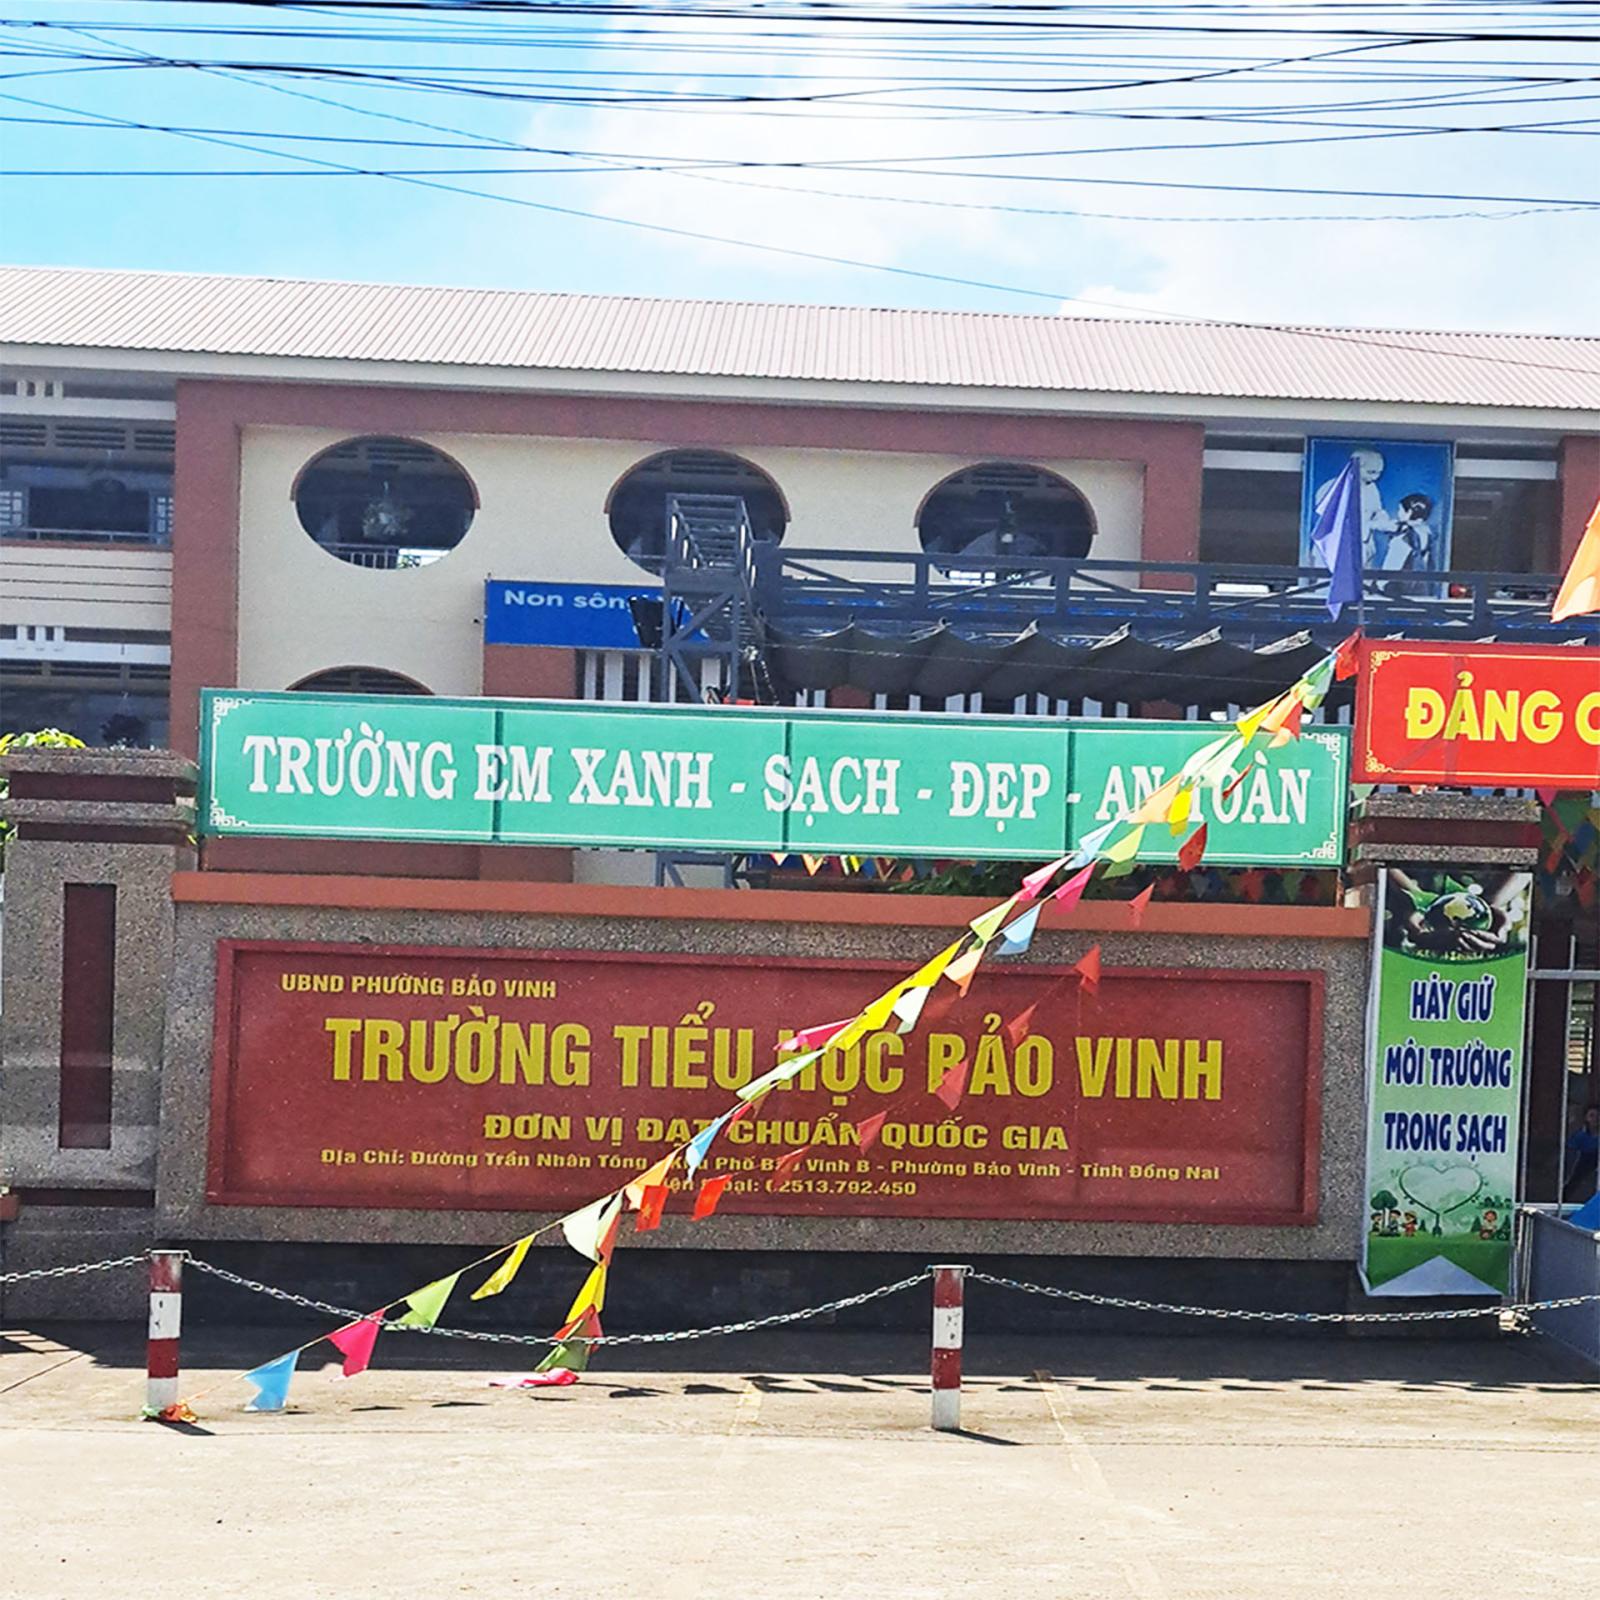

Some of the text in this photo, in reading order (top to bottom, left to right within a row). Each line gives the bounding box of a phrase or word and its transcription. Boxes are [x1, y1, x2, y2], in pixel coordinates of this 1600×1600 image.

[503, 589, 631, 611] Non sôn
[1404, 670, 1564, 744] ĐẢNG
[243, 721, 458, 800] TRƯỜNG
[474, 744, 553, 803] EM
[568, 747, 714, 809] XANH
[763, 753, 900, 828] SẠCH
[949, 760, 1051, 834] ĐẸP
[281, 973, 557, 998] UBND PHƯỜNG BẢO VINH
[325, 1004, 591, 1087] TRƯỜNG
[614, 1000, 754, 1091] TIỂU
[1075, 1036, 1223, 1100] VINH
[1385, 1038, 1512, 1088] MÔI TRƯỜNG
[484, 1112, 571, 1141] ĐƠN
[585, 1116, 623, 1147] VỊ
[881, 1115, 989, 1150] QUỐC
[1002, 1125, 1069, 1151] GIA
[1384, 1112, 1508, 1162] TRONG SẠCH
[411, 1150, 479, 1168] Đường
[536, 1152, 592, 1169] Nhân
[856, 1159, 871, 1174] B
[891, 1160, 968, 1177] Phường
[1185, 1165, 1220, 1181] Nai
